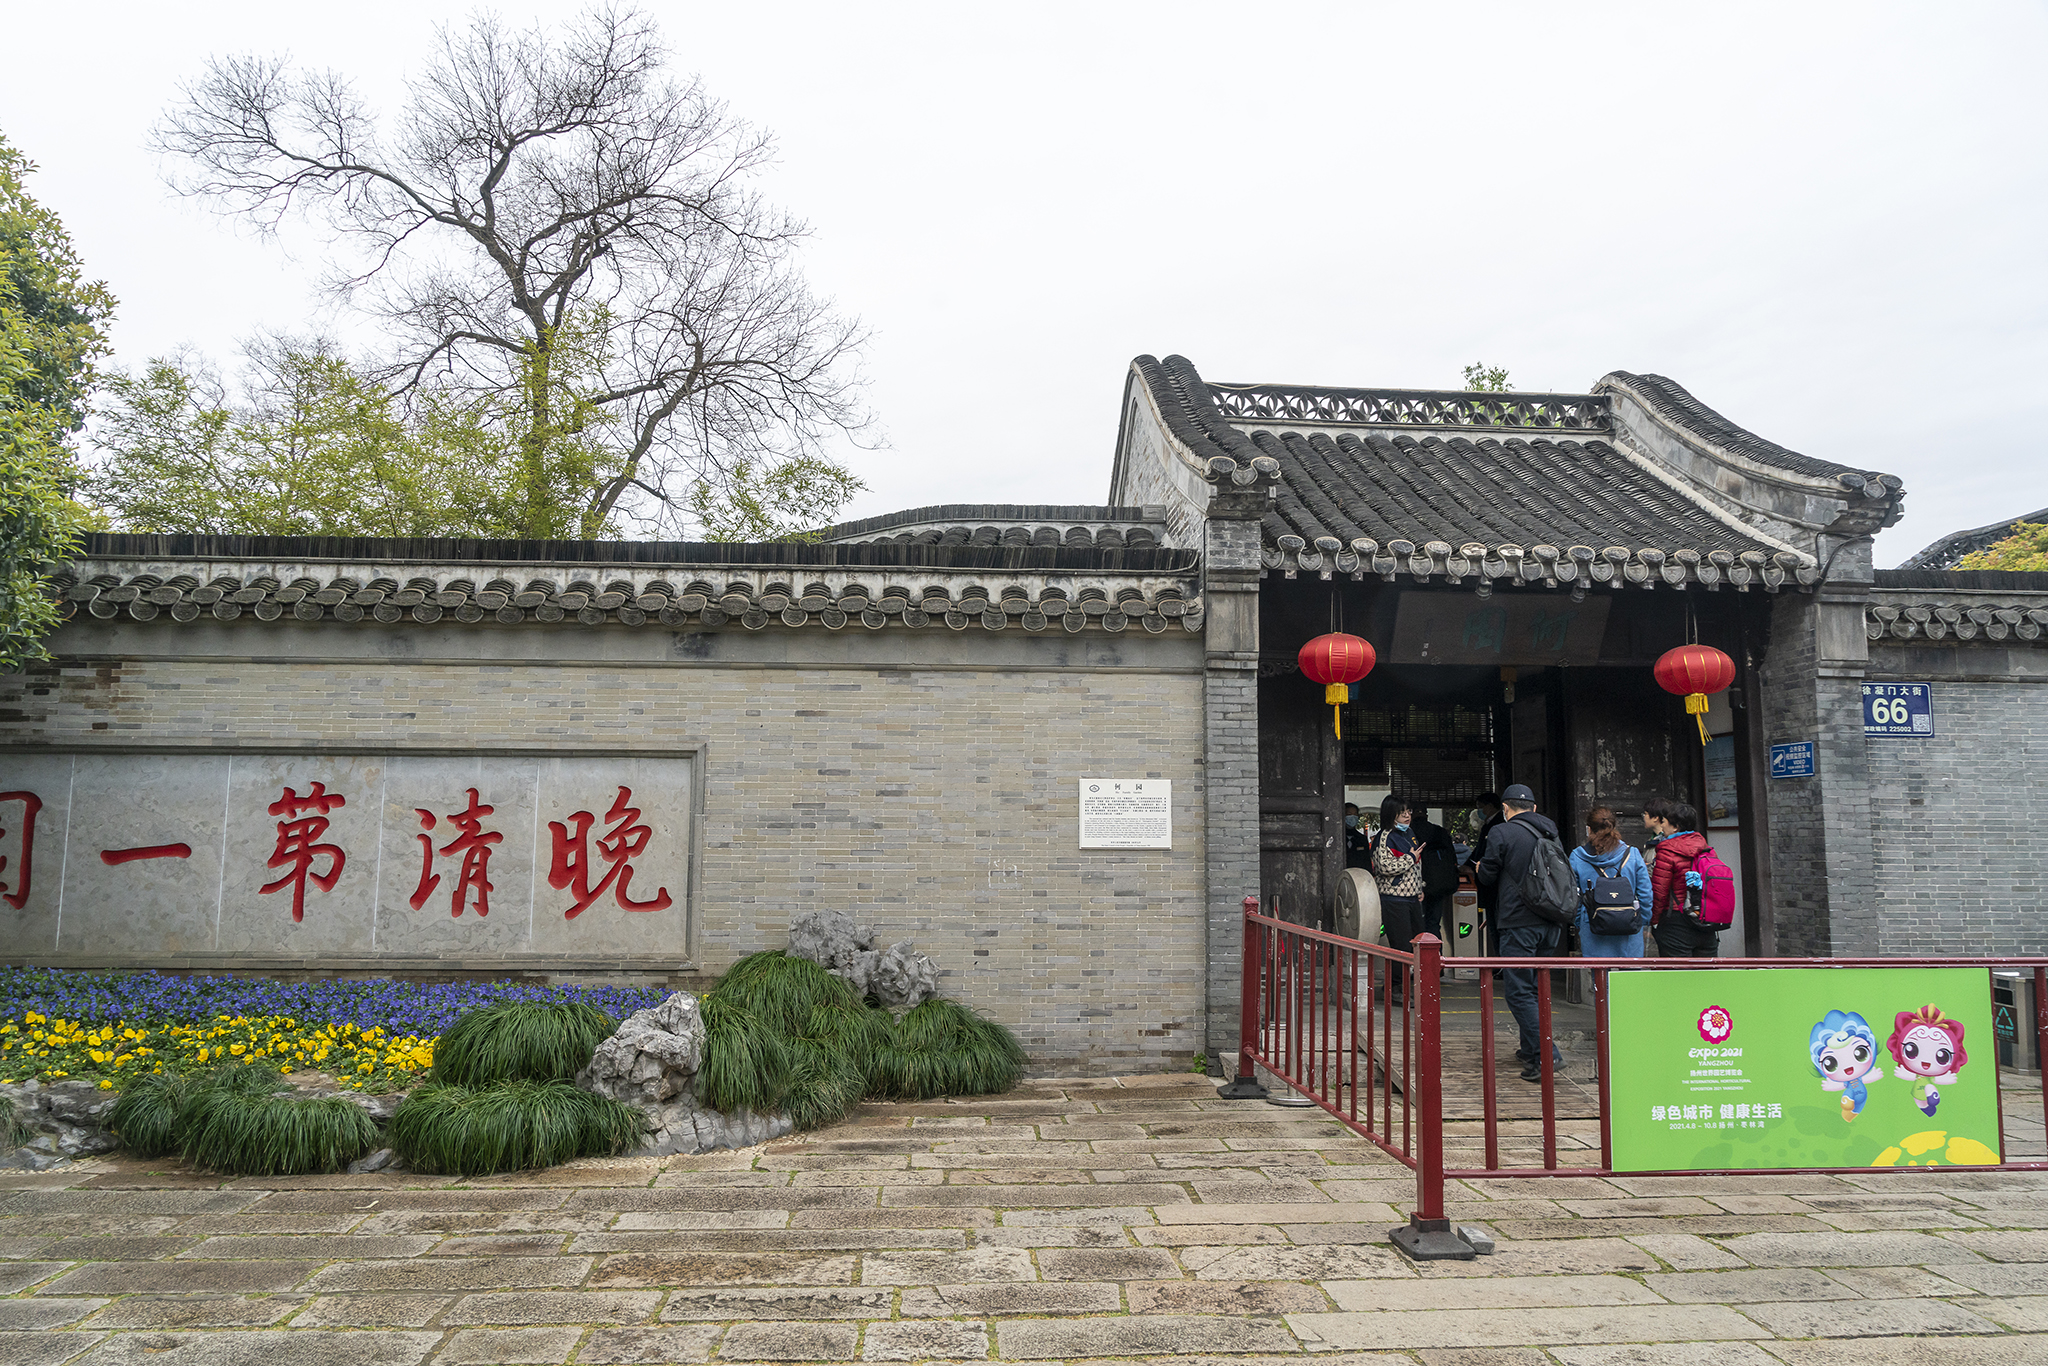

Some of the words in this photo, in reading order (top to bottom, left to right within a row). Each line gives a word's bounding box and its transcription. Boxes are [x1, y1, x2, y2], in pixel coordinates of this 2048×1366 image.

[1862, 686, 1922, 696] 徐凝门大街
[1872, 698, 1909, 724] 66
[1720, 1047, 1743, 1057] 2021
[1690, 1069, 1743, 1077] 扬州世界园艺博览会
[1651, 1104, 1713, 1121] 绿色城市
[1719, 1103, 1782, 1119] 健康生活
